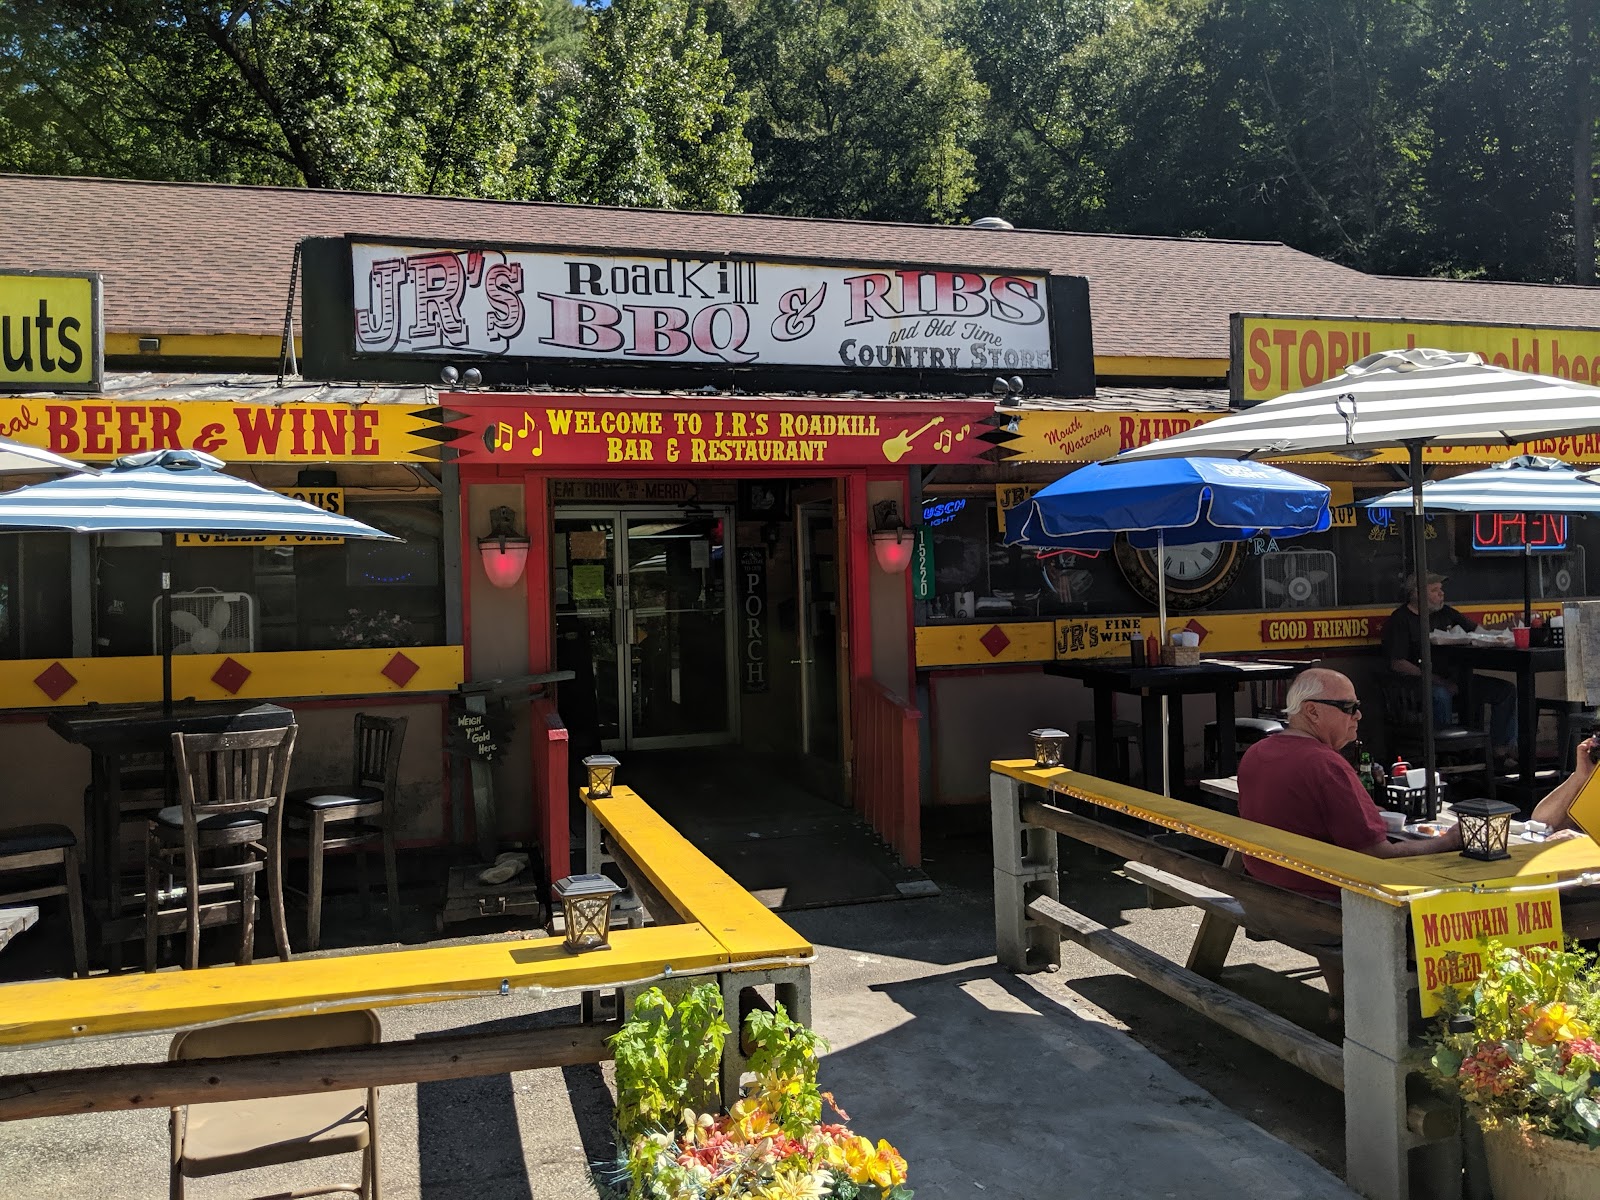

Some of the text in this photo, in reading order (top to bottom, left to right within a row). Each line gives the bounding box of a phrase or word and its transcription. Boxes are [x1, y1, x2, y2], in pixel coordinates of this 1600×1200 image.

[538, 270, 1046, 364] BBQ & RIBS
[888, 318, 1002, 347] and Old Time
[838, 339, 1050, 370] COUNTRY STORE
[45, 405, 183, 454] BEER
[193, 422, 228, 453] &
[233, 407, 379, 456] WINE
[546, 409, 664, 436] WELCOME
[674, 412, 703, 435] TO
[779, 413, 881, 437] ROADKILL
[1043, 416, 1084, 446] Mouth
[606, 438, 829, 463] BAR & RESTAURANT
[1059, 423, 1113, 456] Watering
[554, 482, 689, 499] EAT DRINK MERRY
[919, 530, 928, 596] 15220
[745, 573, 764, 683] PORCH
[1100, 631, 1141, 642] WIN
[1105, 618, 1141, 630] FINE
[1269, 617, 1369, 641] GOOD FRIENDS
[458, 715, 482, 727] WEIGH
[465, 725, 484, 739] your
[471, 730, 491, 744] Gold
[478, 743, 497, 755] Here
[1421, 900, 1553, 948] MOUNTAIN MAN
